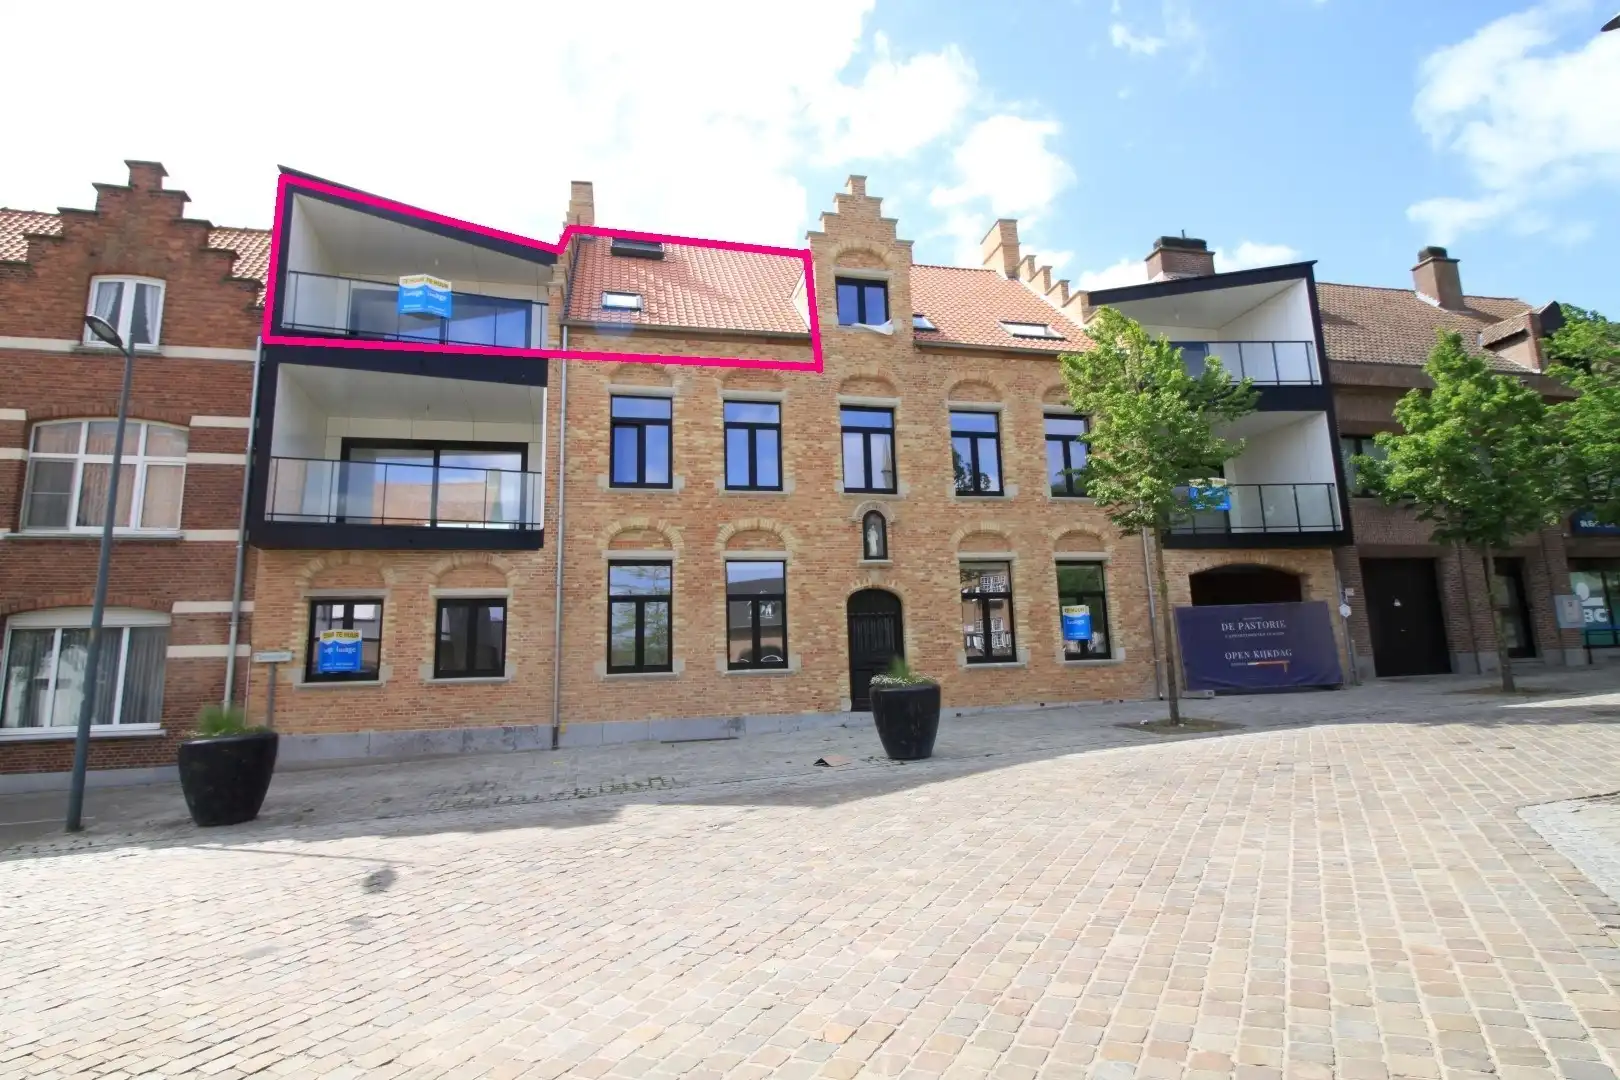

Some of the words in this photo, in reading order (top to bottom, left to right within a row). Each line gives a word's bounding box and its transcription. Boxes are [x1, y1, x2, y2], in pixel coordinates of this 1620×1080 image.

[1583, 608, 1608, 623] BC
[1221, 622, 1235, 631] DE
[1238, 620, 1287, 631] PASTORIE
[1224, 650, 1250, 660] OPEN
[1252, 648, 1293, 660] KIJKDAG
